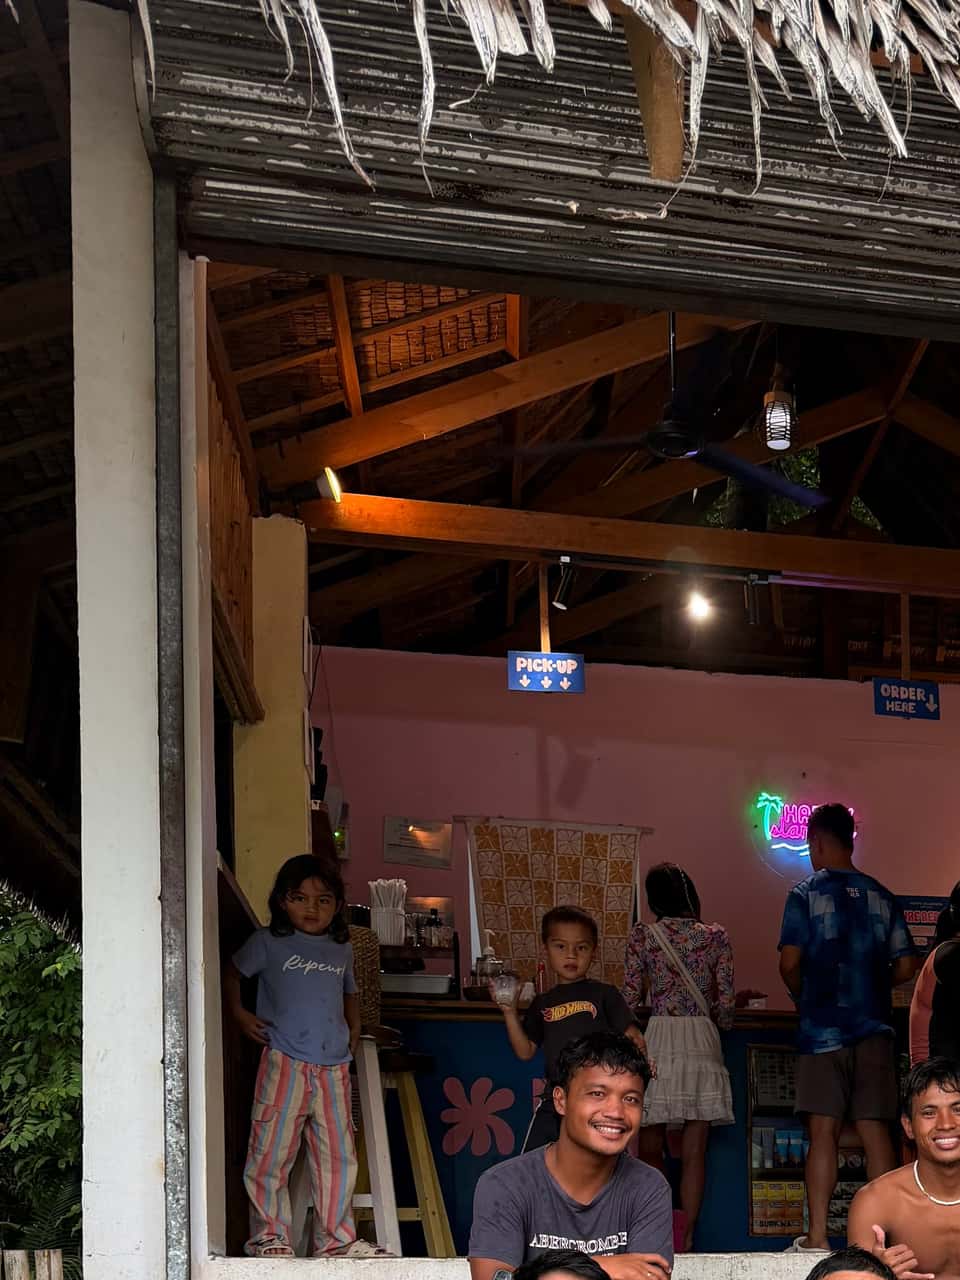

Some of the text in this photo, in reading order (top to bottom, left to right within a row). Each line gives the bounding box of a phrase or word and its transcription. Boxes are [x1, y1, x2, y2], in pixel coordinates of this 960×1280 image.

[516, 657, 578, 674] PICK-UP
[881, 684, 926, 701] ORDER
[886, 701, 917, 713] HERE
